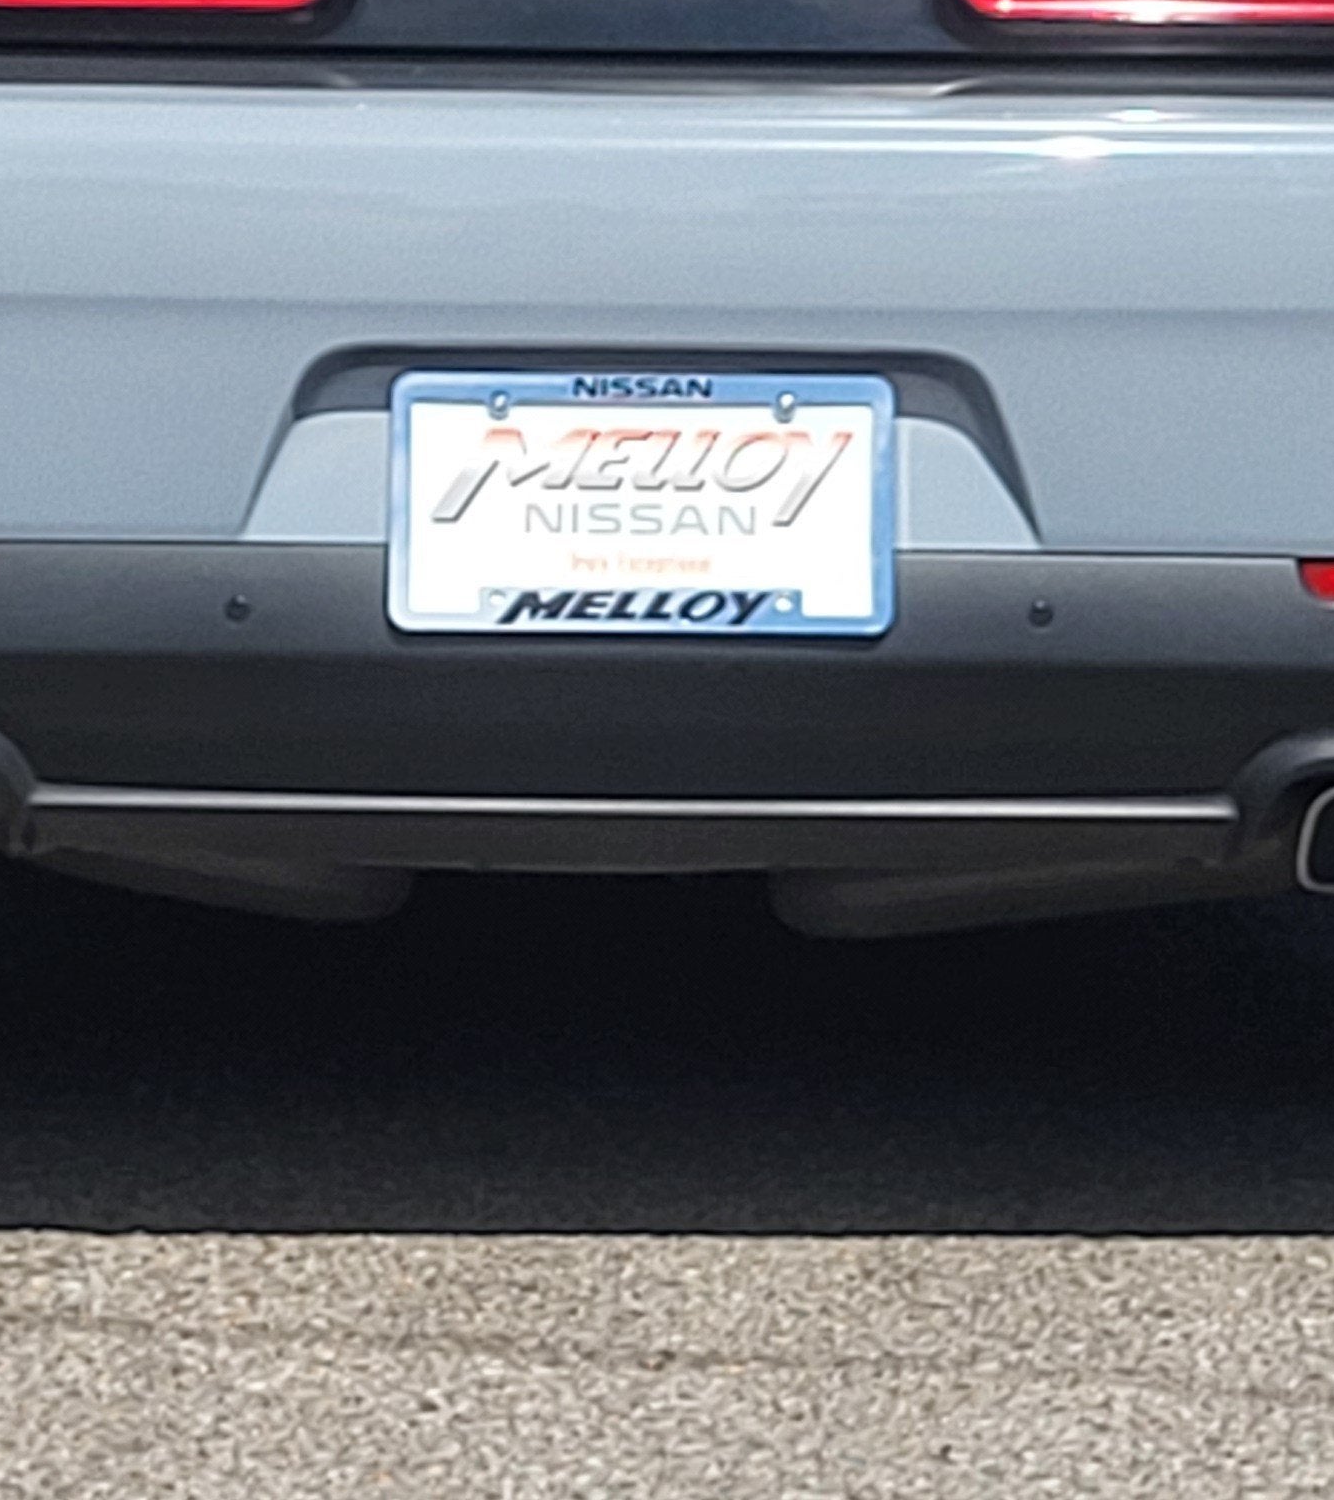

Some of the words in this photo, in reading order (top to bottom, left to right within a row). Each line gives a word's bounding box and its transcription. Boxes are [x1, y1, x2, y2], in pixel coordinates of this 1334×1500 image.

[572, 376, 714, 399] NISSAN
[432, 427, 854, 527] MELLOY
[524, 503, 757, 536] NISSAN
[496, 589, 767, 626] MELLOY
